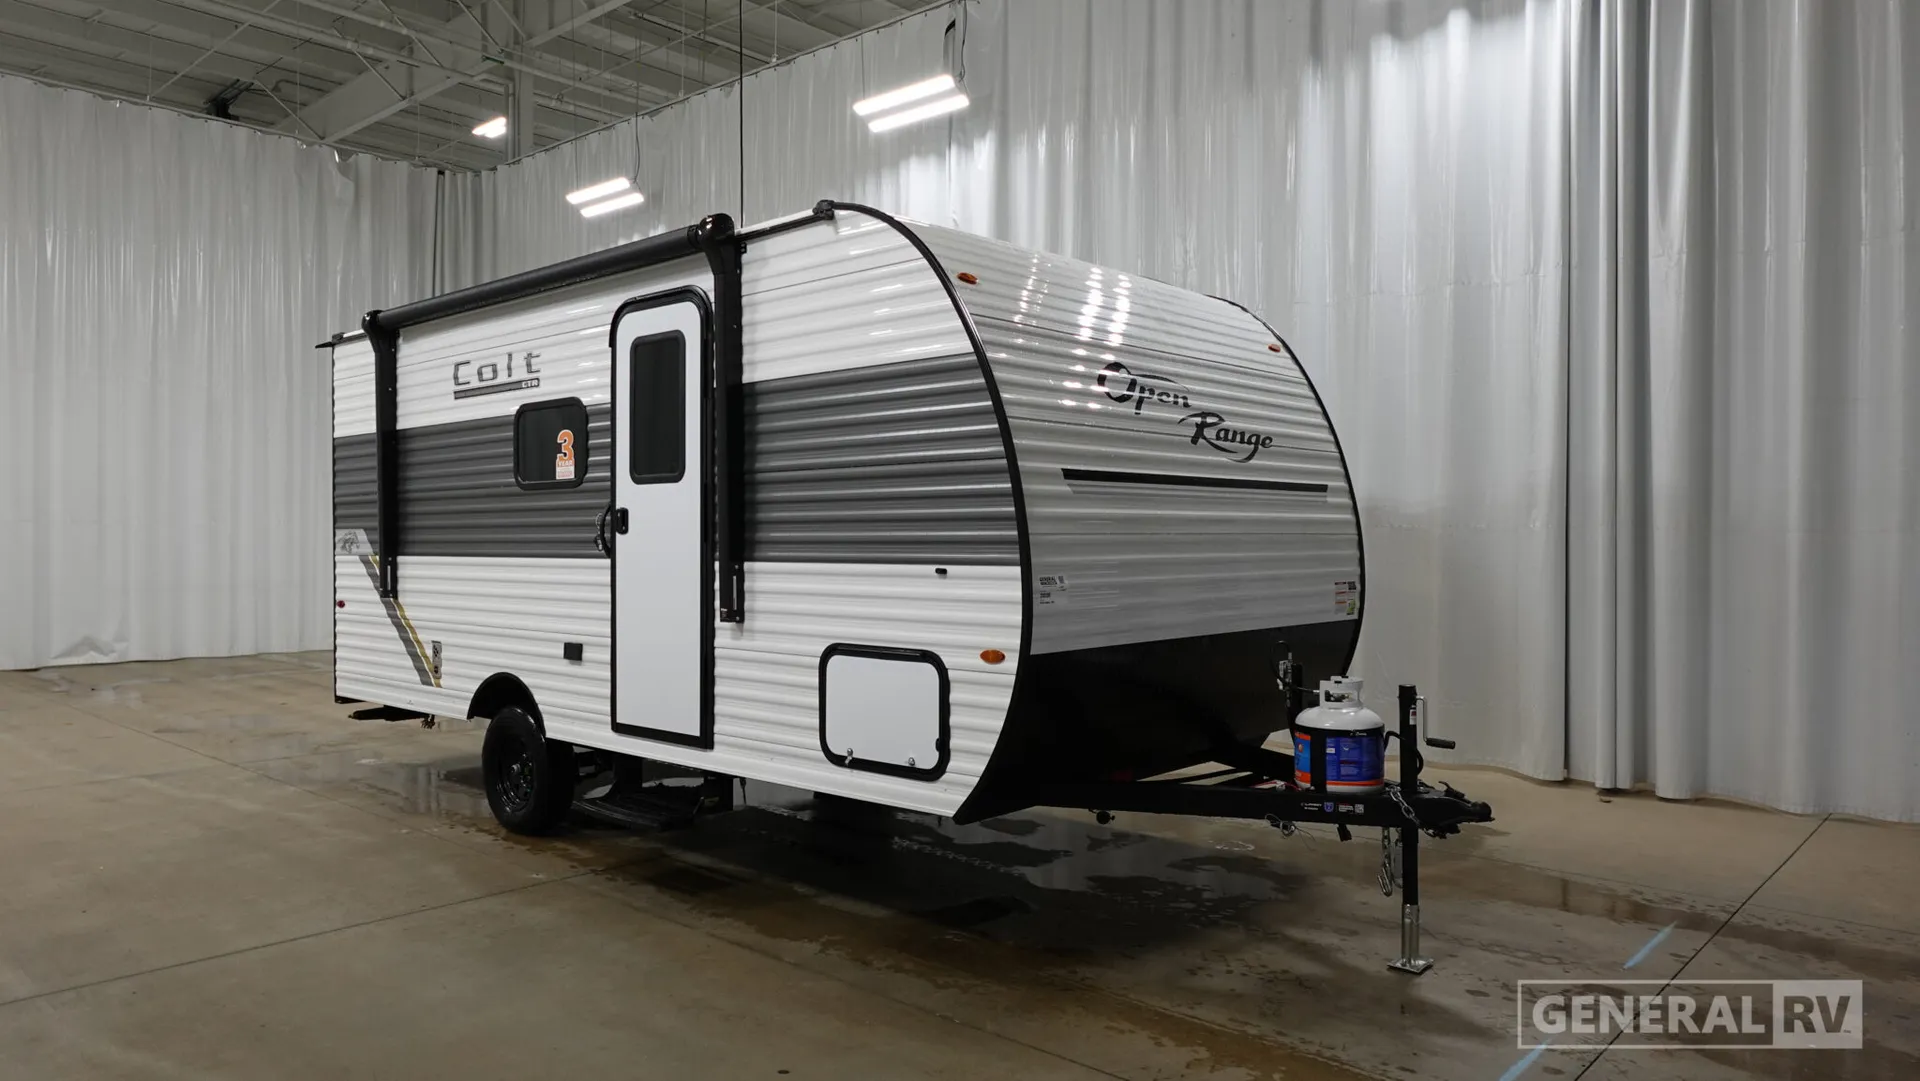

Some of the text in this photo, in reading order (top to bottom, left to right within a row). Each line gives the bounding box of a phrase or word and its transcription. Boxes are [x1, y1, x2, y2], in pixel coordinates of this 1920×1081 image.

[453, 352, 541, 386] Colt
[521, 379, 539, 388] CTR
[1097, 361, 1192, 415] Open
[557, 429, 574, 461] 3
[1177, 411, 1273, 463] Range
